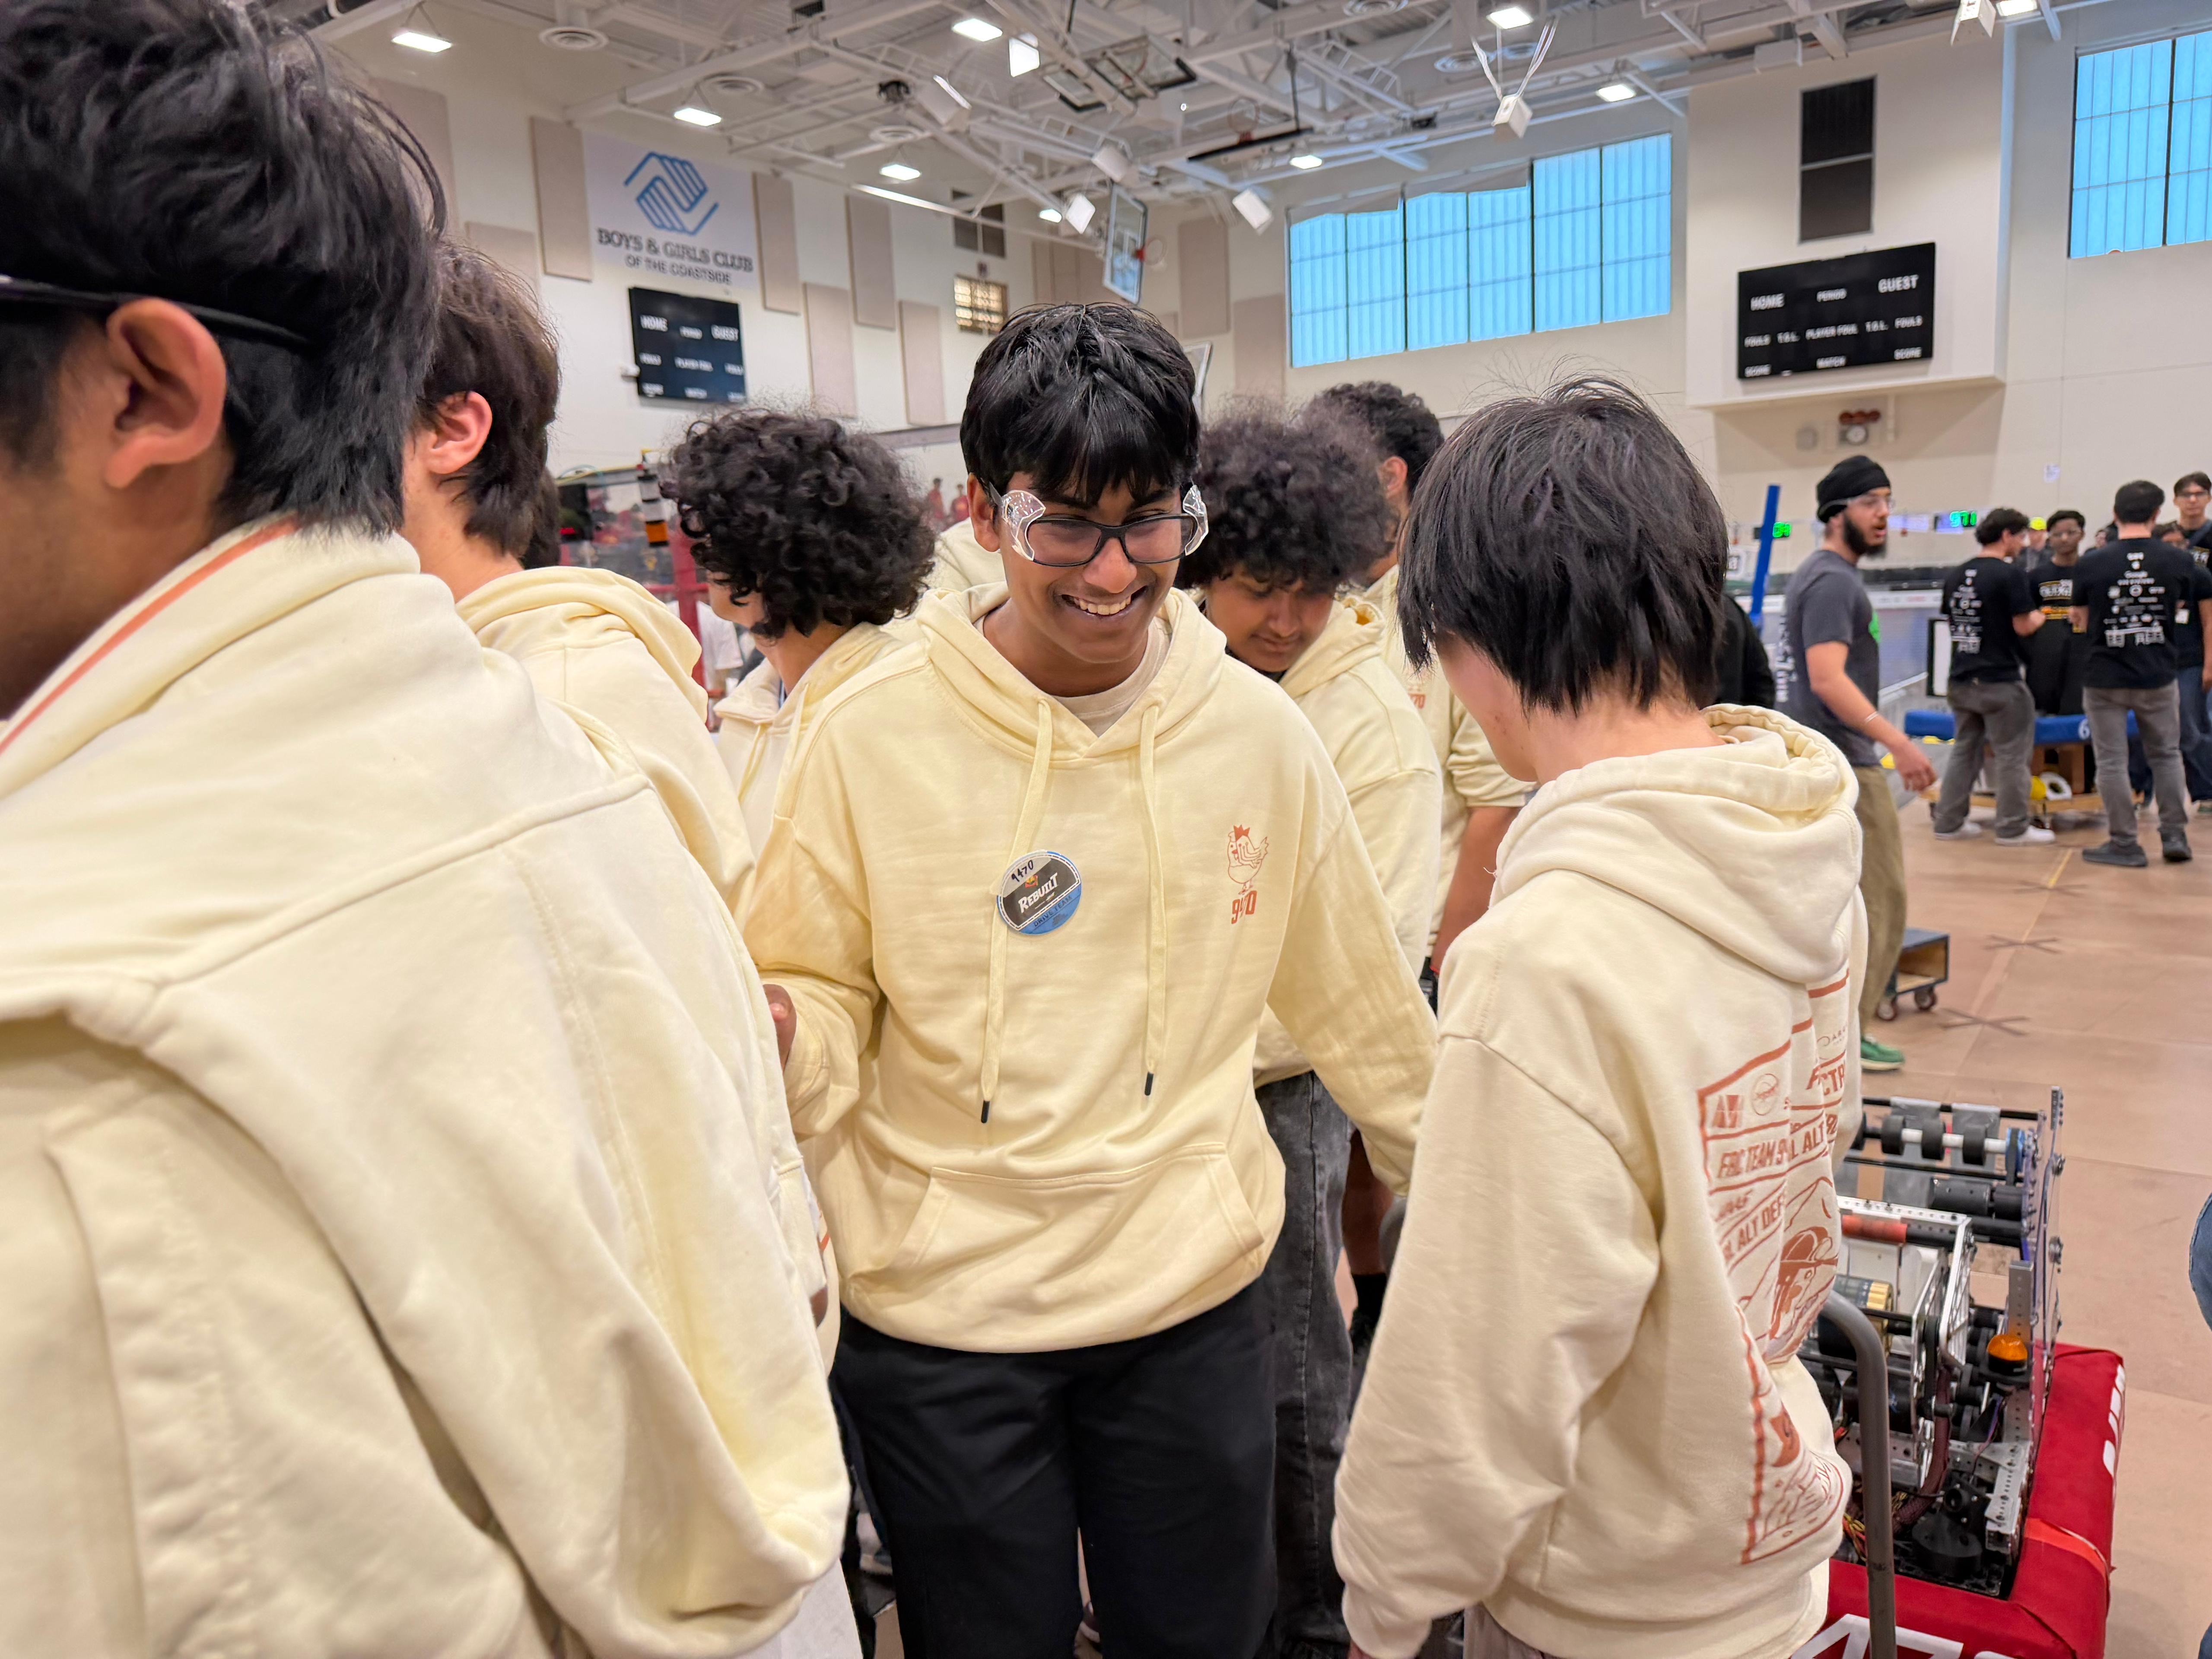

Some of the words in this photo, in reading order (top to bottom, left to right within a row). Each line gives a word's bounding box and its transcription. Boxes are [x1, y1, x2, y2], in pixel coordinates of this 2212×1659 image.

[597, 228, 643, 252] BOYS
[647, 237, 660, 255] &
[663, 241, 711, 264] GIRLS
[712, 251, 754, 273] CLUB
[626, 254, 641, 268] OF
[645, 258, 667, 274] THE
[670, 263, 731, 284] COASTSIDE
[1878, 274, 1919, 293] GUEST
[1750, 292, 1785, 311] HOME
[1894, 315, 1923, 329] FOULS
[1011, 860, 1034, 882] 9470
[1018, 872, 1058, 913] REBUILT
[1034, 910, 1053, 927] DRIVE
